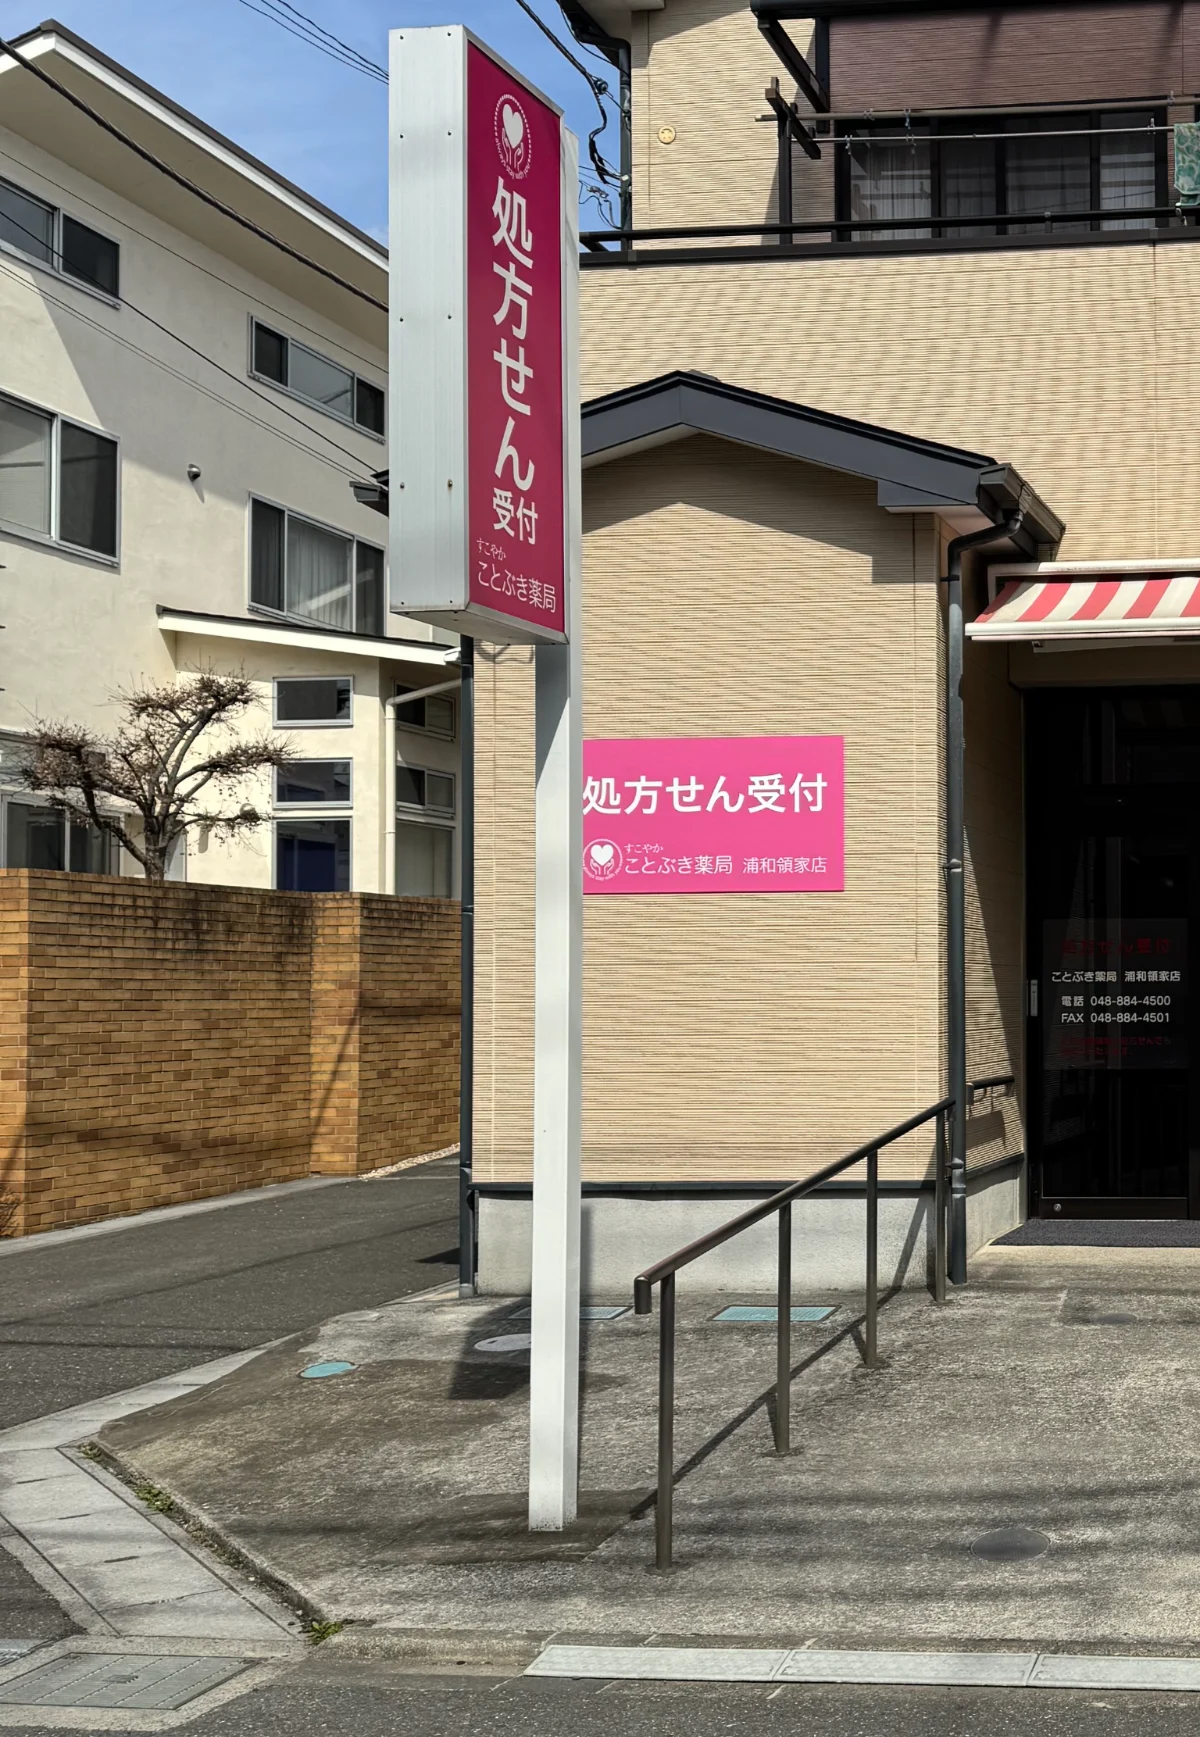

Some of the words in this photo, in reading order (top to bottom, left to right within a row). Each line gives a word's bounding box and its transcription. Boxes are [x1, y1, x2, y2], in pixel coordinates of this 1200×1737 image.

[492, 176, 534, 491] 処方せん
[492, 487, 538, 545] 受付
[476, 537, 506, 561] すこやか
[478, 561, 556, 613] ことぶき薬局
[582, 773, 828, 815] 処方せん受付
[623, 843, 664, 854] すこやか
[624, 855, 733, 875] ことぶき薬局
[742, 856, 828, 875] 浦和領家店
[1051, 971, 1117, 983] ことぶき薬局
[1124, 971, 1181, 983] 浦和領家店
[1061, 996, 1084, 1007] 電話
[1090, 995, 1171, 1006] 048-884-4500
[1061, 1013, 1084, 1023] FAX
[1090, 1013, 1170, 1023] 048-884-4501
